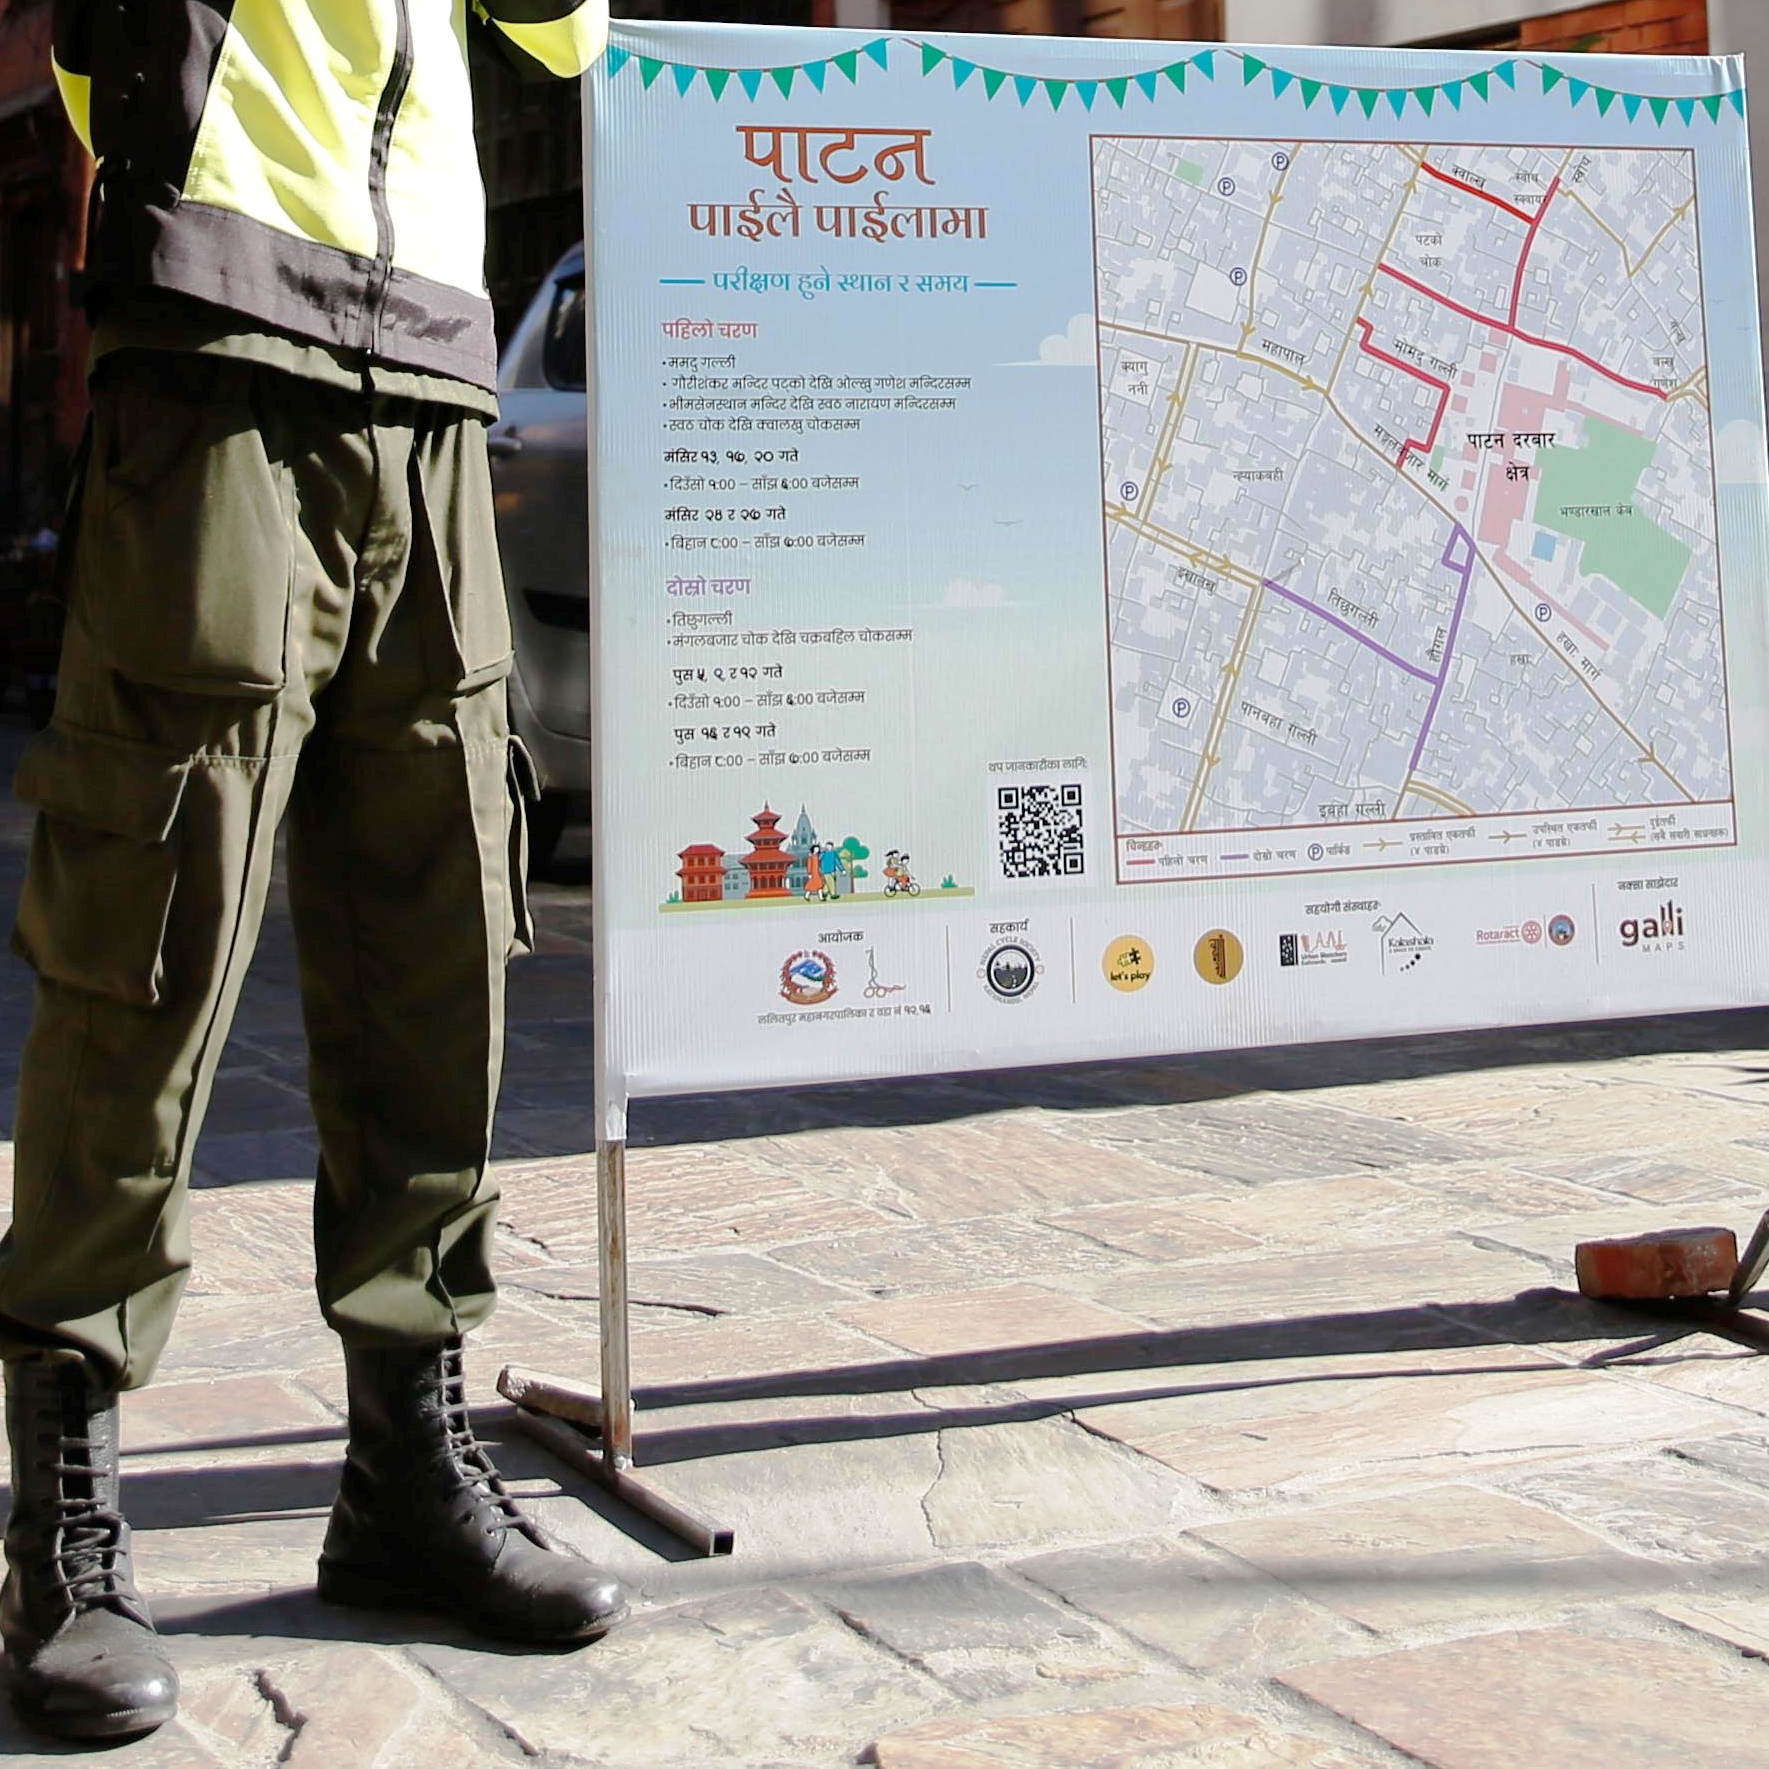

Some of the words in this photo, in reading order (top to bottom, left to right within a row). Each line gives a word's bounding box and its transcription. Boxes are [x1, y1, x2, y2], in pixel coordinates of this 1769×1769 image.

[736, 124, 934, 186] पाटन
[688, 188, 801, 243] पाईलै
[815, 192, 989, 243] पाईलामा
[713, 266, 790, 293] परीक्षण
[798, 265, 832, 300] हुने
[837, 276, 892, 294] स्थान
[898, 277, 910, 292] र
[916, 277, 968, 293] समय
[662, 318, 713, 340] पहिलो
[719, 322, 759, 339] चरण
[701, 354, 736, 369] गल्ली
[733, 375, 769, 390] मन्दिर
[809, 375, 833, 390] देखि
[874, 375, 906, 389] गणेश
[909, 374, 971, 389] मन्दिरसम्म
[750, 395, 787, 410] मन्दिर
[790, 395, 814, 410] देखि
[845, 398, 891, 410] नारायण
[894, 395, 956, 410] मन्दिरसम्म
[699, 417, 725, 431] चोक
[728, 416, 753, 431] देखि
[808, 417, 861, 430] चोकसम्म
[1467, 432, 1504, 449] पाटन
[664, 447, 697, 463] मंसिर
[779, 447, 799, 462] गते
[670, 474, 704, 491] दिउँसो
[751, 474, 778, 490] साँझ
[665, 506, 699, 521] मंसिर
[727, 510, 735, 521] र
[766, 504, 787, 520] गते
[754, 533, 781, 548] साँझ
[666, 576, 706, 596] दोस्रो
[711, 579, 751, 595] चरण
[741, 630, 768, 646] चोक
[772, 628, 796, 645] देखि
[858, 626, 913, 643] चोकसम्म
[673, 668, 693, 686] पुस
[730, 667, 737, 680] र
[762, 663, 783, 679] गते
[674, 693, 709, 709] दिउँसो
[756, 691, 783, 707] साँझ
[675, 726, 694, 745] पुस
[723, 727, 730, 739] र
[756, 722, 776, 737] गते
[759, 750, 786, 766] साँझ
[989, 917, 1029, 934] सहकार्य
[1619, 900, 1684, 947] galli
[819, 929, 864, 943] आयोजक
[1476, 927, 1520, 942] Rotaract
[1642, 942, 1684, 953] MAPS
